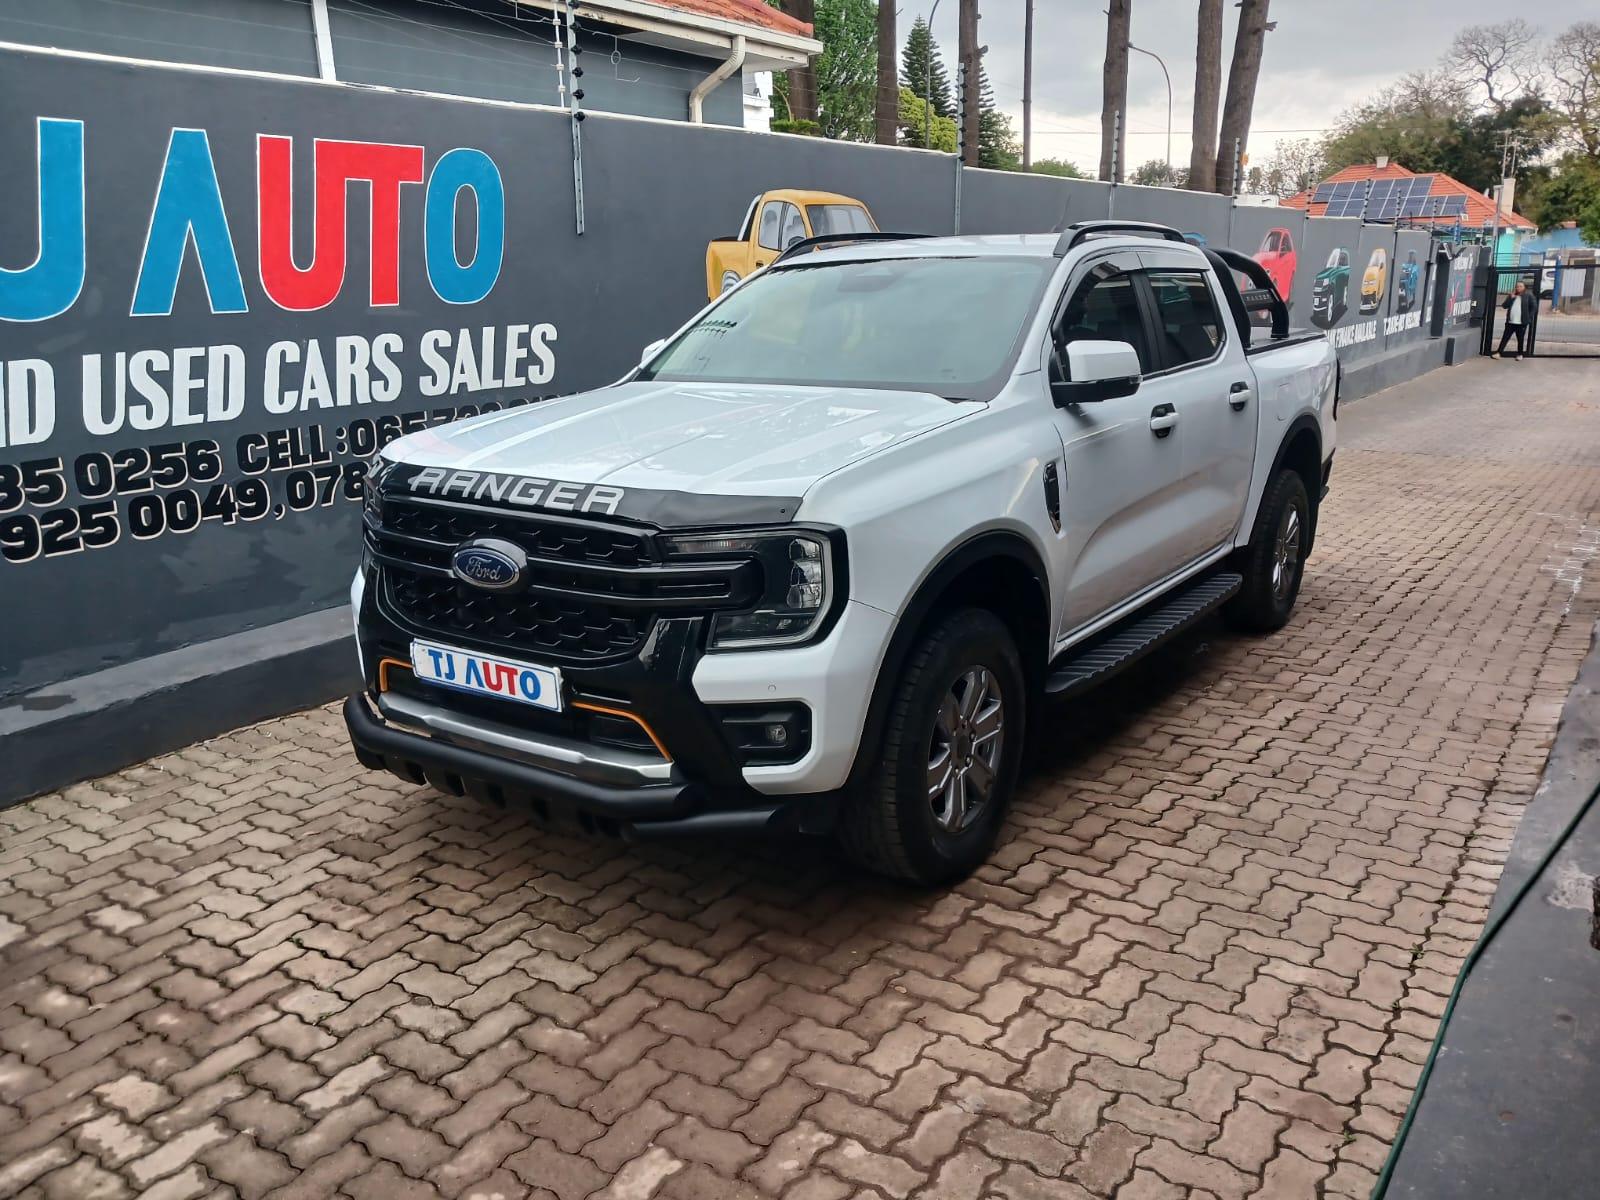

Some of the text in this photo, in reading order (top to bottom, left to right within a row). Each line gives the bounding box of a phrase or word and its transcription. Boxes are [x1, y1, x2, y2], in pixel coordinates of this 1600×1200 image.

[129, 127, 505, 317] AUTO
[0, 323, 558, 449] D USED CARS SALES
[74, 440, 223, 499] 0256
[407, 467, 625, 515] RANGER
[0, 500, 121, 563] 925
[465, 556, 501, 580] Ford
[427, 648, 541, 701] TJ AUTO
